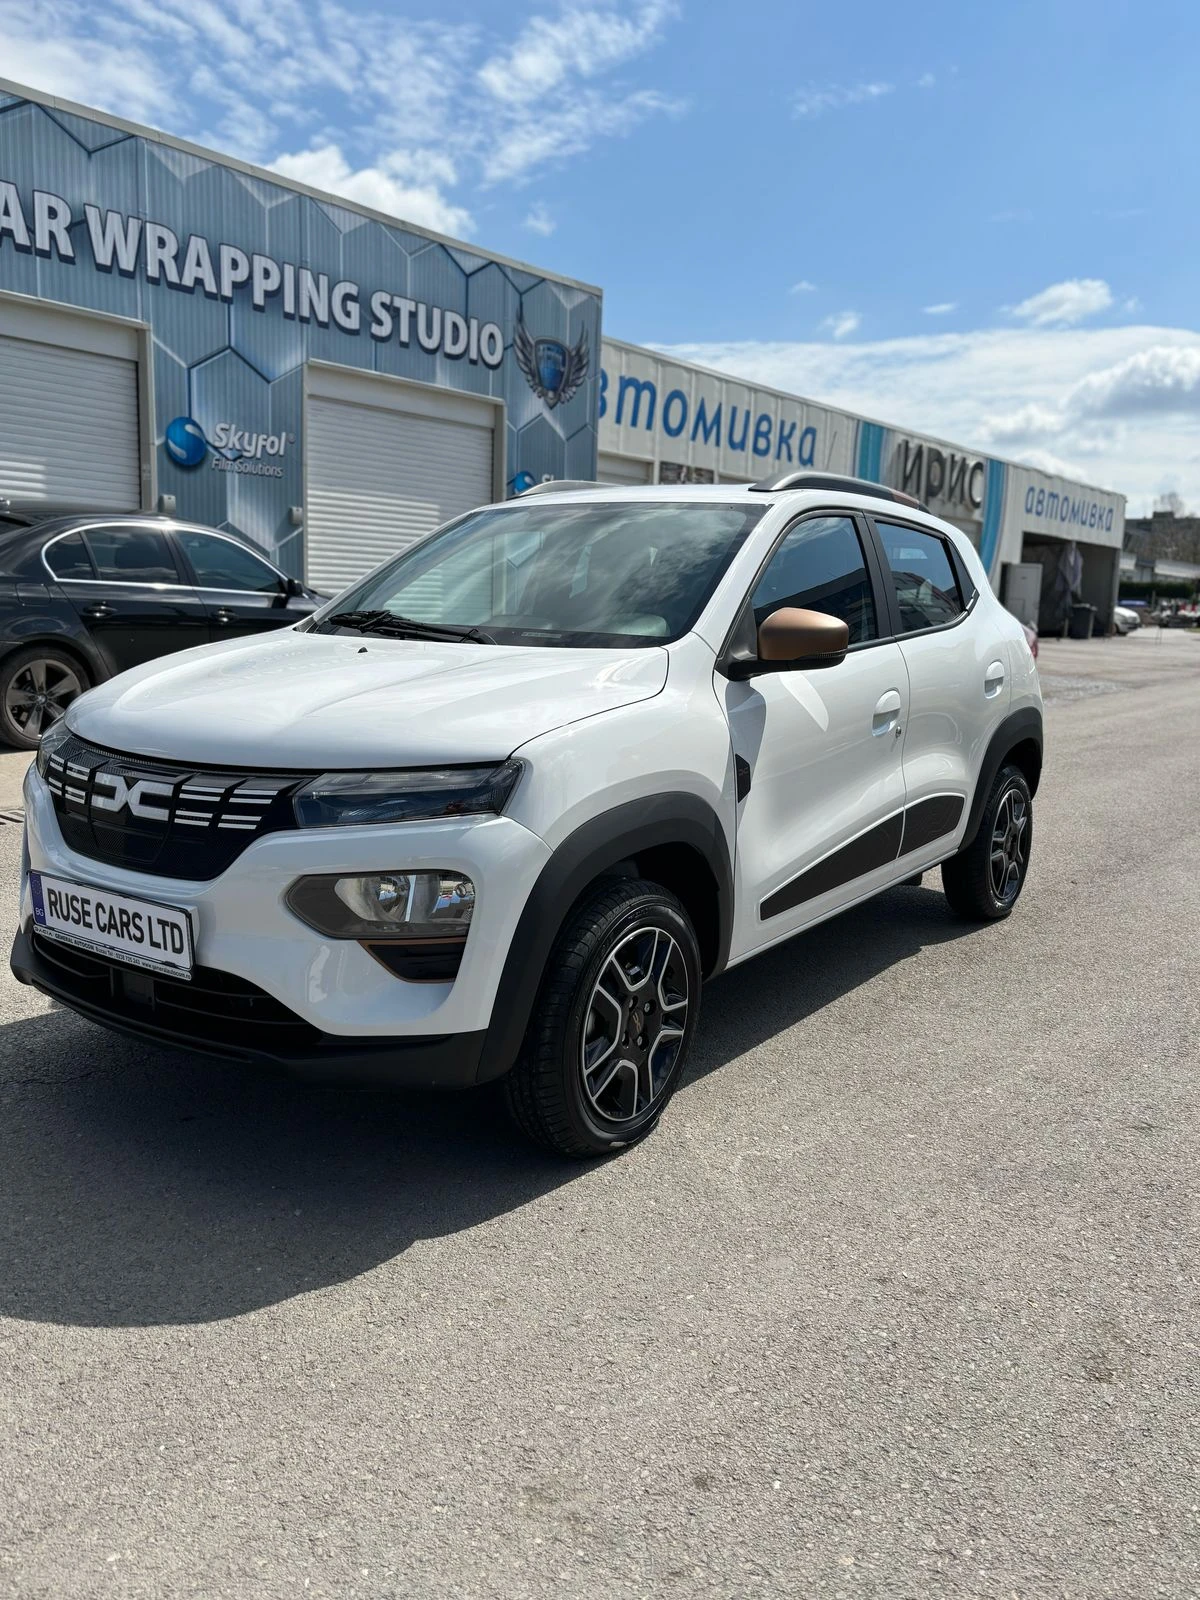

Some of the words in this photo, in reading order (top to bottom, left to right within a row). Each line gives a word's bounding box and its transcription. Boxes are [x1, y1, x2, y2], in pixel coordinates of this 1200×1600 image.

[84, 203, 362, 332] WRAPPING
[371, 291, 505, 368] STUDIO
[212, 456, 235, 473] Film
[236, 459, 284, 478] Solutions
[1025, 486, 1114, 532] автомивка
[34, 906, 44, 917] BG
[47, 888, 93, 929] RUSE
[95, 902, 145, 943] CARS
[147, 915, 184, 954] LTD
[55, 933, 73, 944] GENERAL
